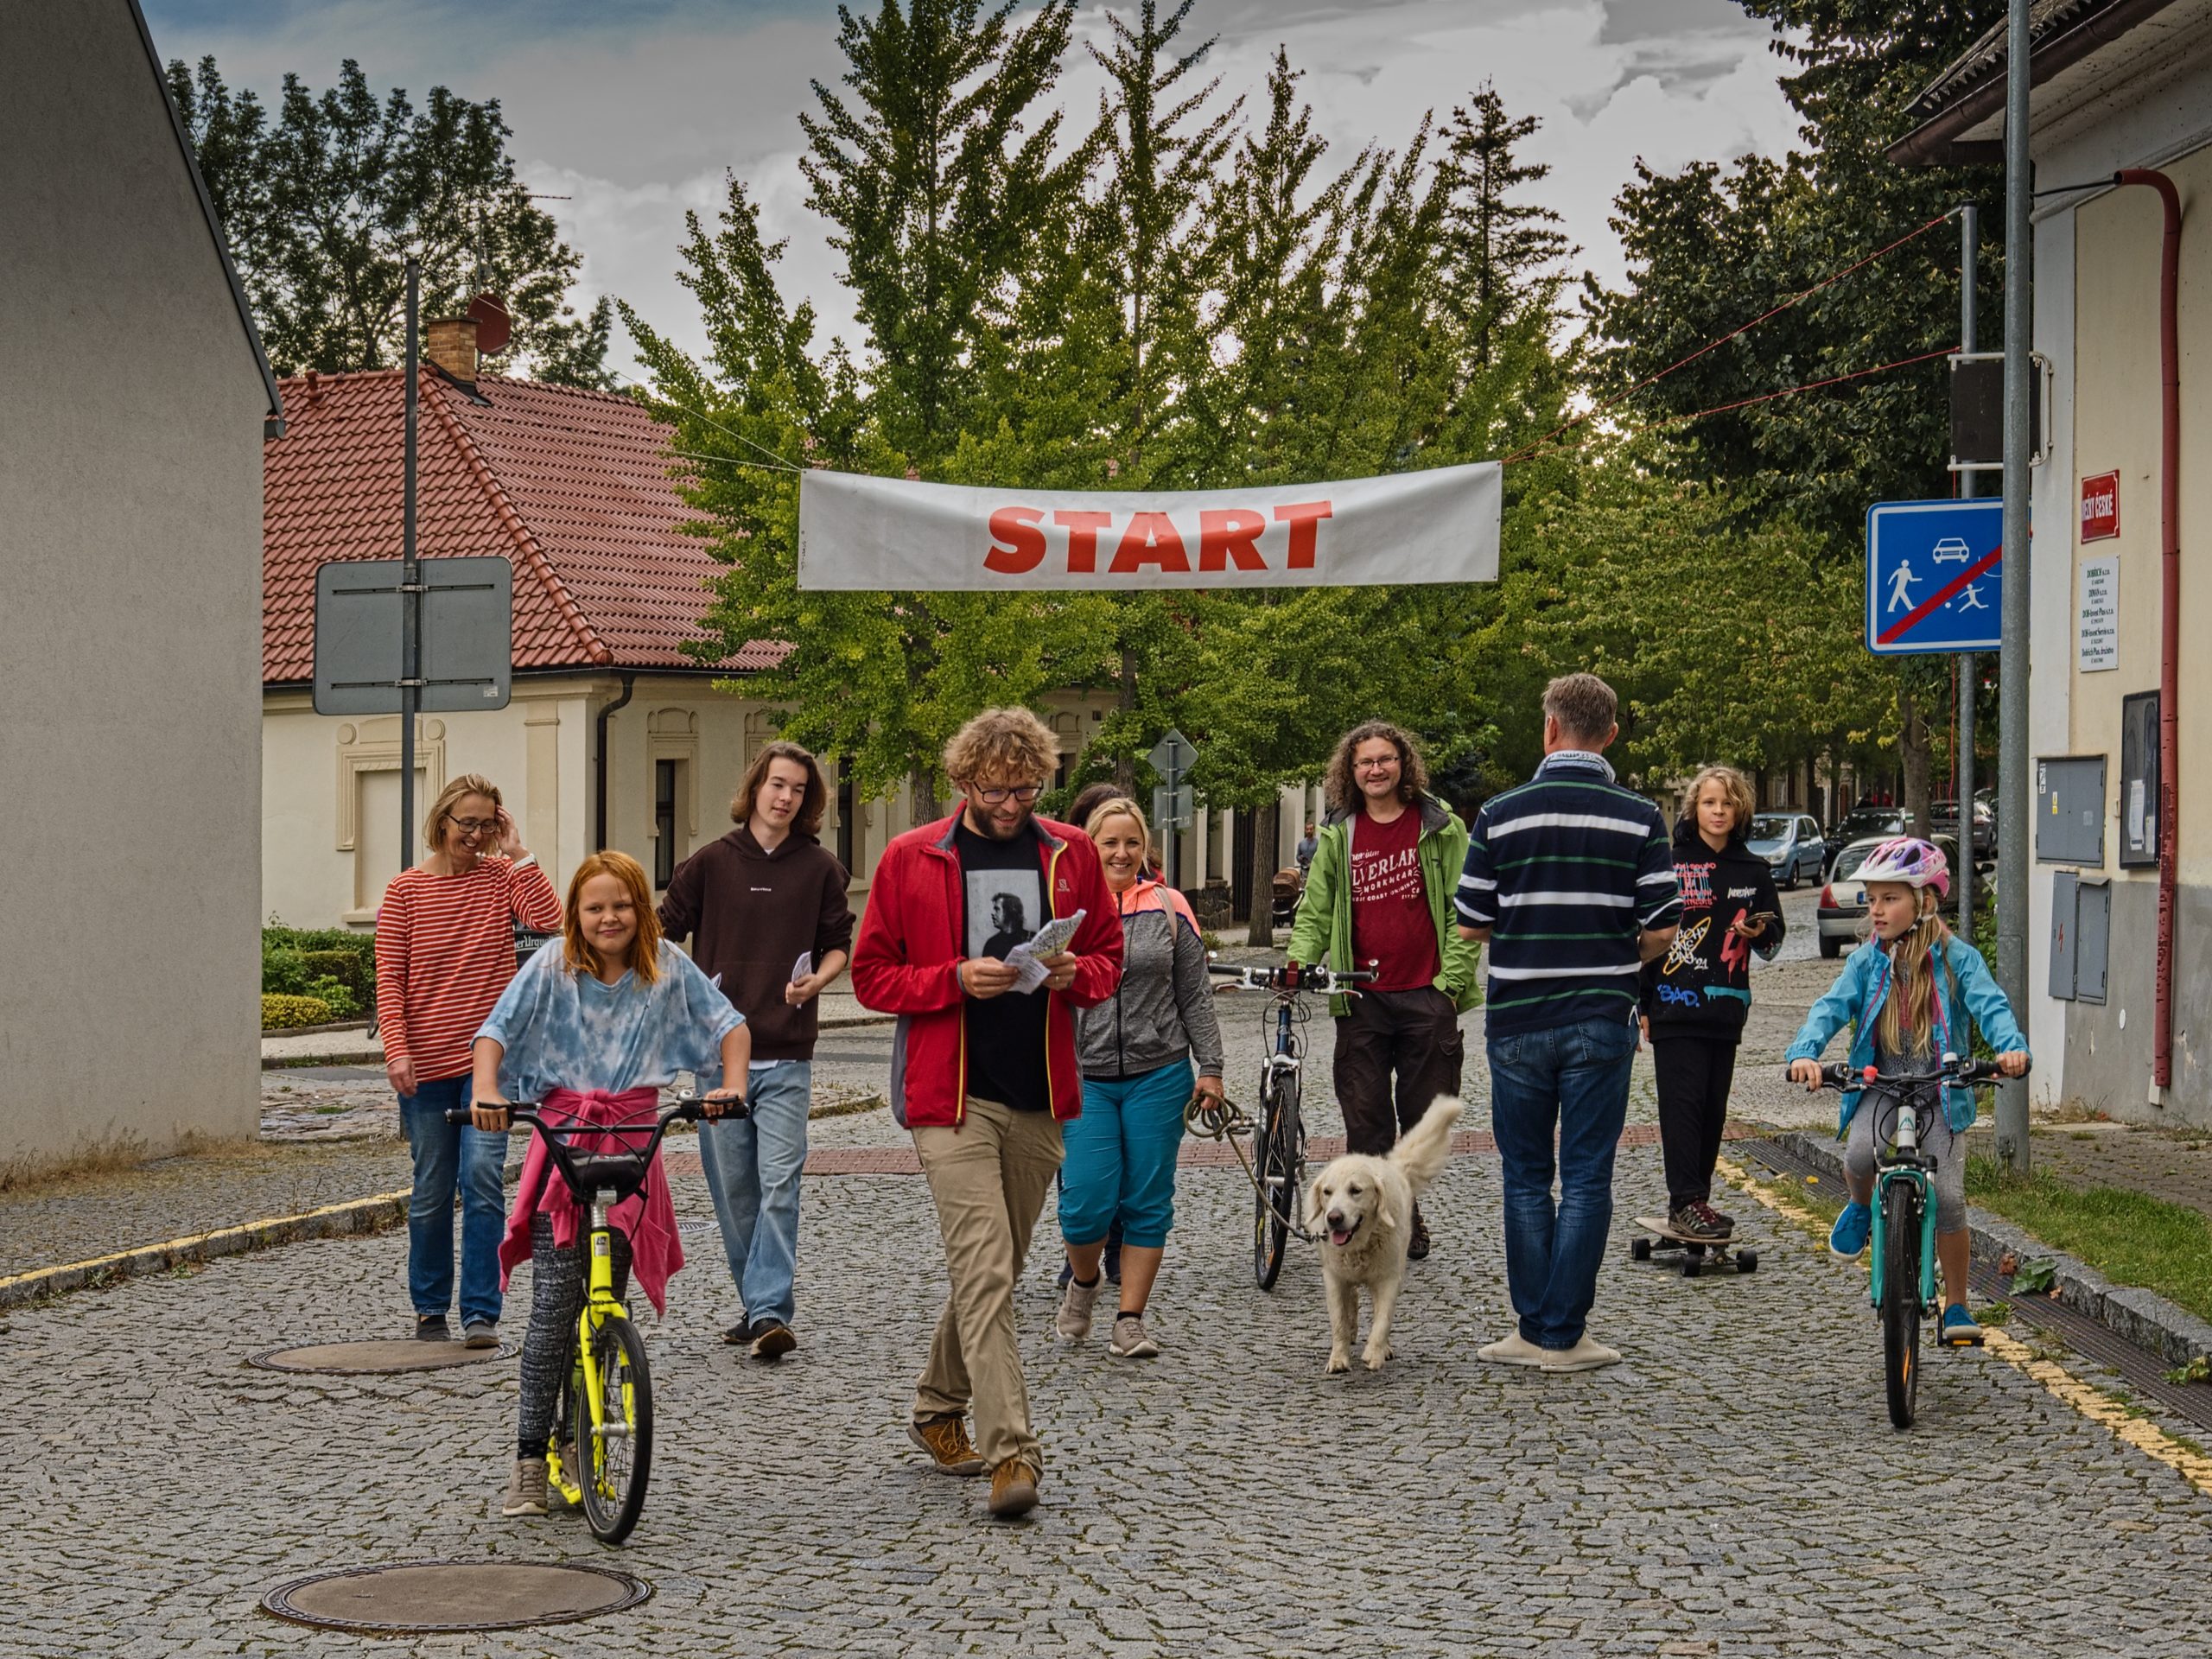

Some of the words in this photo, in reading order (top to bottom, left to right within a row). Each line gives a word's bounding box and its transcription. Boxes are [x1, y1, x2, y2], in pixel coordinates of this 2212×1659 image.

[2094, 488, 2113, 518] ČESKÉ
[983, 500, 1332, 574] START
[1352, 848, 1421, 887] LVERLAK
[1367, 893, 1388, 902] COAST
